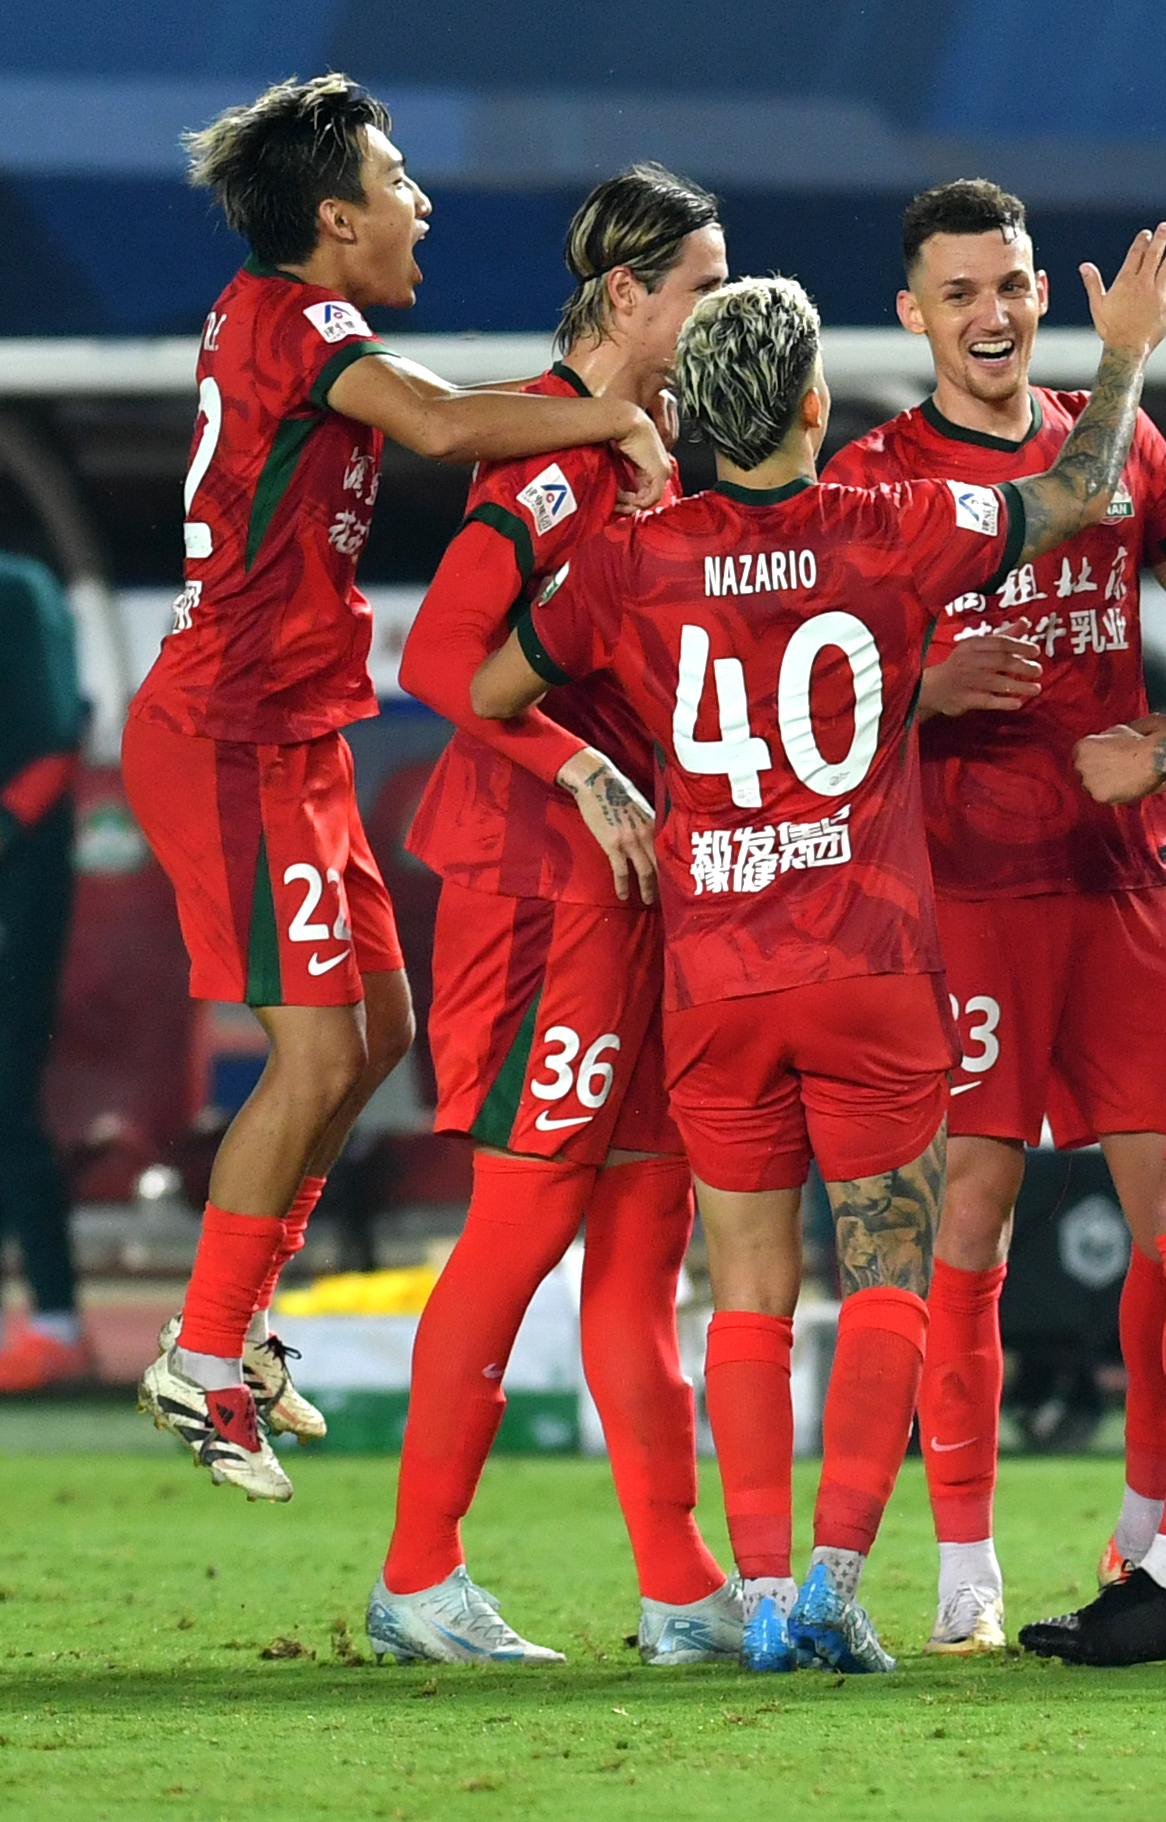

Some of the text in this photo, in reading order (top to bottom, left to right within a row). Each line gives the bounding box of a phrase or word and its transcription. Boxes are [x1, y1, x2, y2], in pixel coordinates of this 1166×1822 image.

[704, 549, 817, 597] NAZARIO
[953, 607, 1130, 658] 牛乳业
[672, 610, 883, 808] 40
[530, 1025, 621, 1109] 36
[948, 992, 1001, 1073] 3
